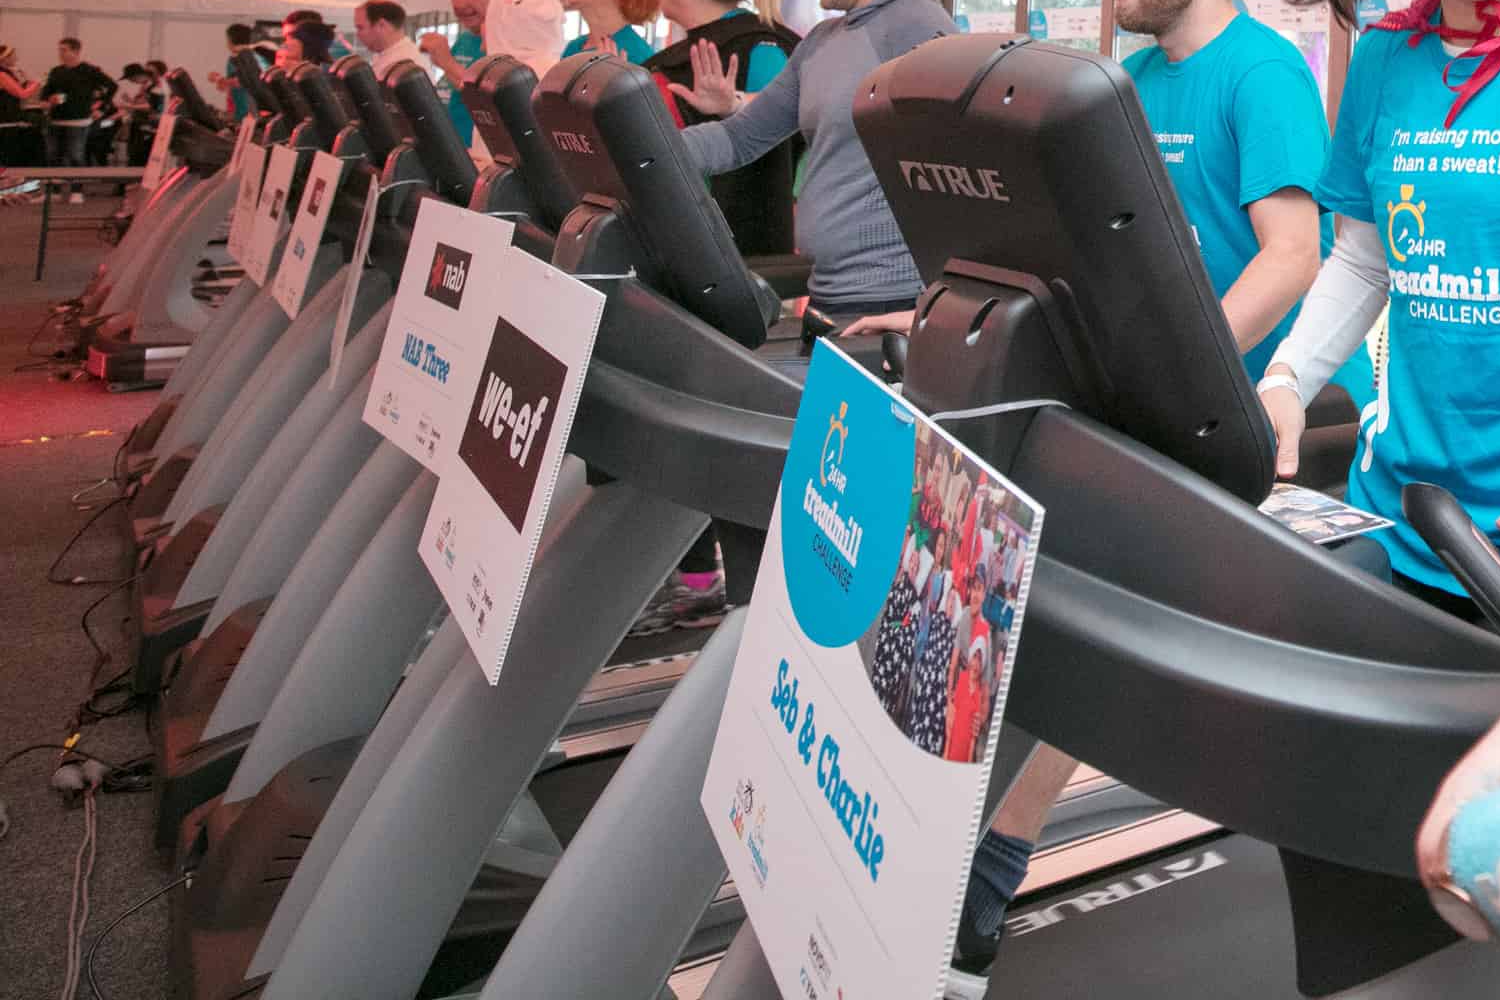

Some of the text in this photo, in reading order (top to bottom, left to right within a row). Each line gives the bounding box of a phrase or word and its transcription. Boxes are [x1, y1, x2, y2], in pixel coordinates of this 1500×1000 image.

[1391, 128, 1410, 147] I'm
[1413, 128, 1468, 148] raising
[1392, 153, 1425, 172] than
[1427, 158, 1437, 172] a
[924, 166, 1011, 202] TRUE
[442, 260, 465, 293] nab
[401, 332, 450, 385] NAB Three
[478, 371, 549, 468] we-ef
[803, 478, 863, 569] treadmill
[811, 533, 853, 593] CHALLENGE
[770, 657, 884, 884] Seb & Charlie
[1004, 872, 1172, 937] TRUE
